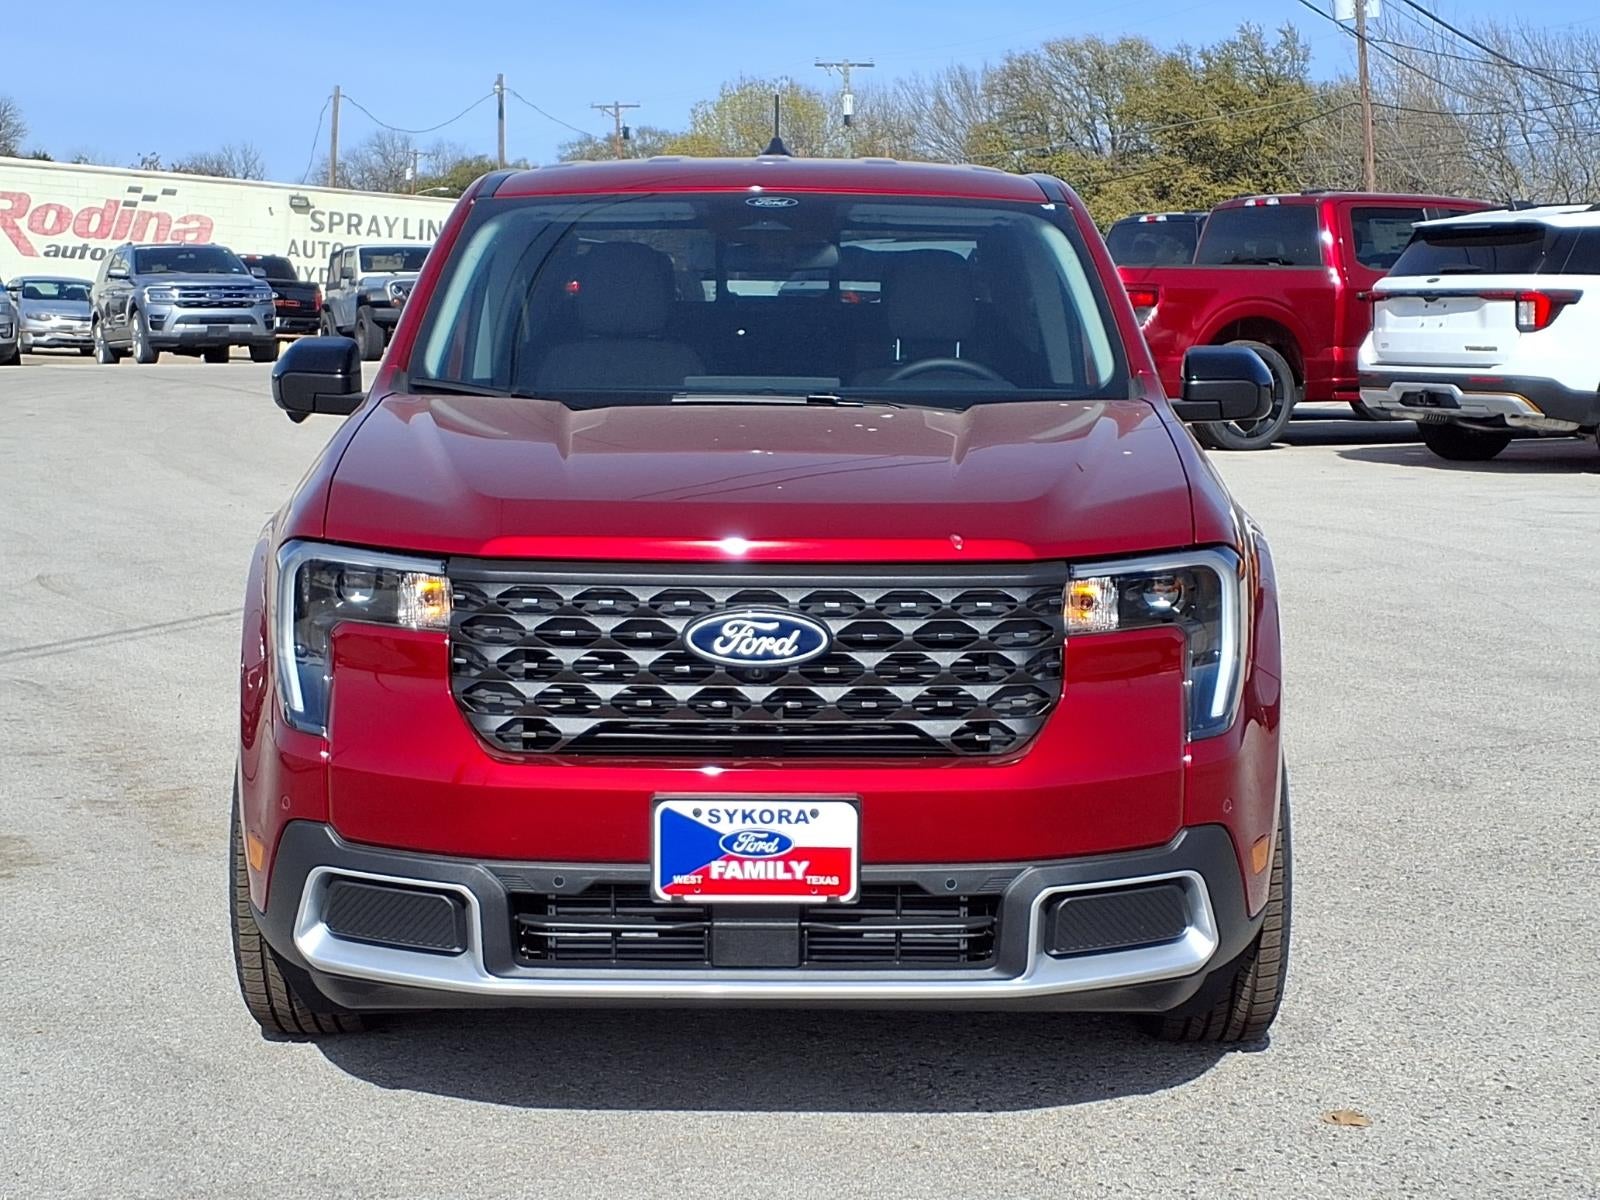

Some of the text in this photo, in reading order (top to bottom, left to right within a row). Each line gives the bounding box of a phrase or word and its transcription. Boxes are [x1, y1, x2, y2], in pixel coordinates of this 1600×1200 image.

[0, 191, 214, 258] Rodina
[43, 243, 114, 261] auto
[713, 619, 801, 656] Ford
[707, 808, 810, 825] SYKORA
[732, 830, 780, 854] Ford
[708, 860, 810, 880] FAMILY
[672, 875, 840, 886] WEST TEXAS
